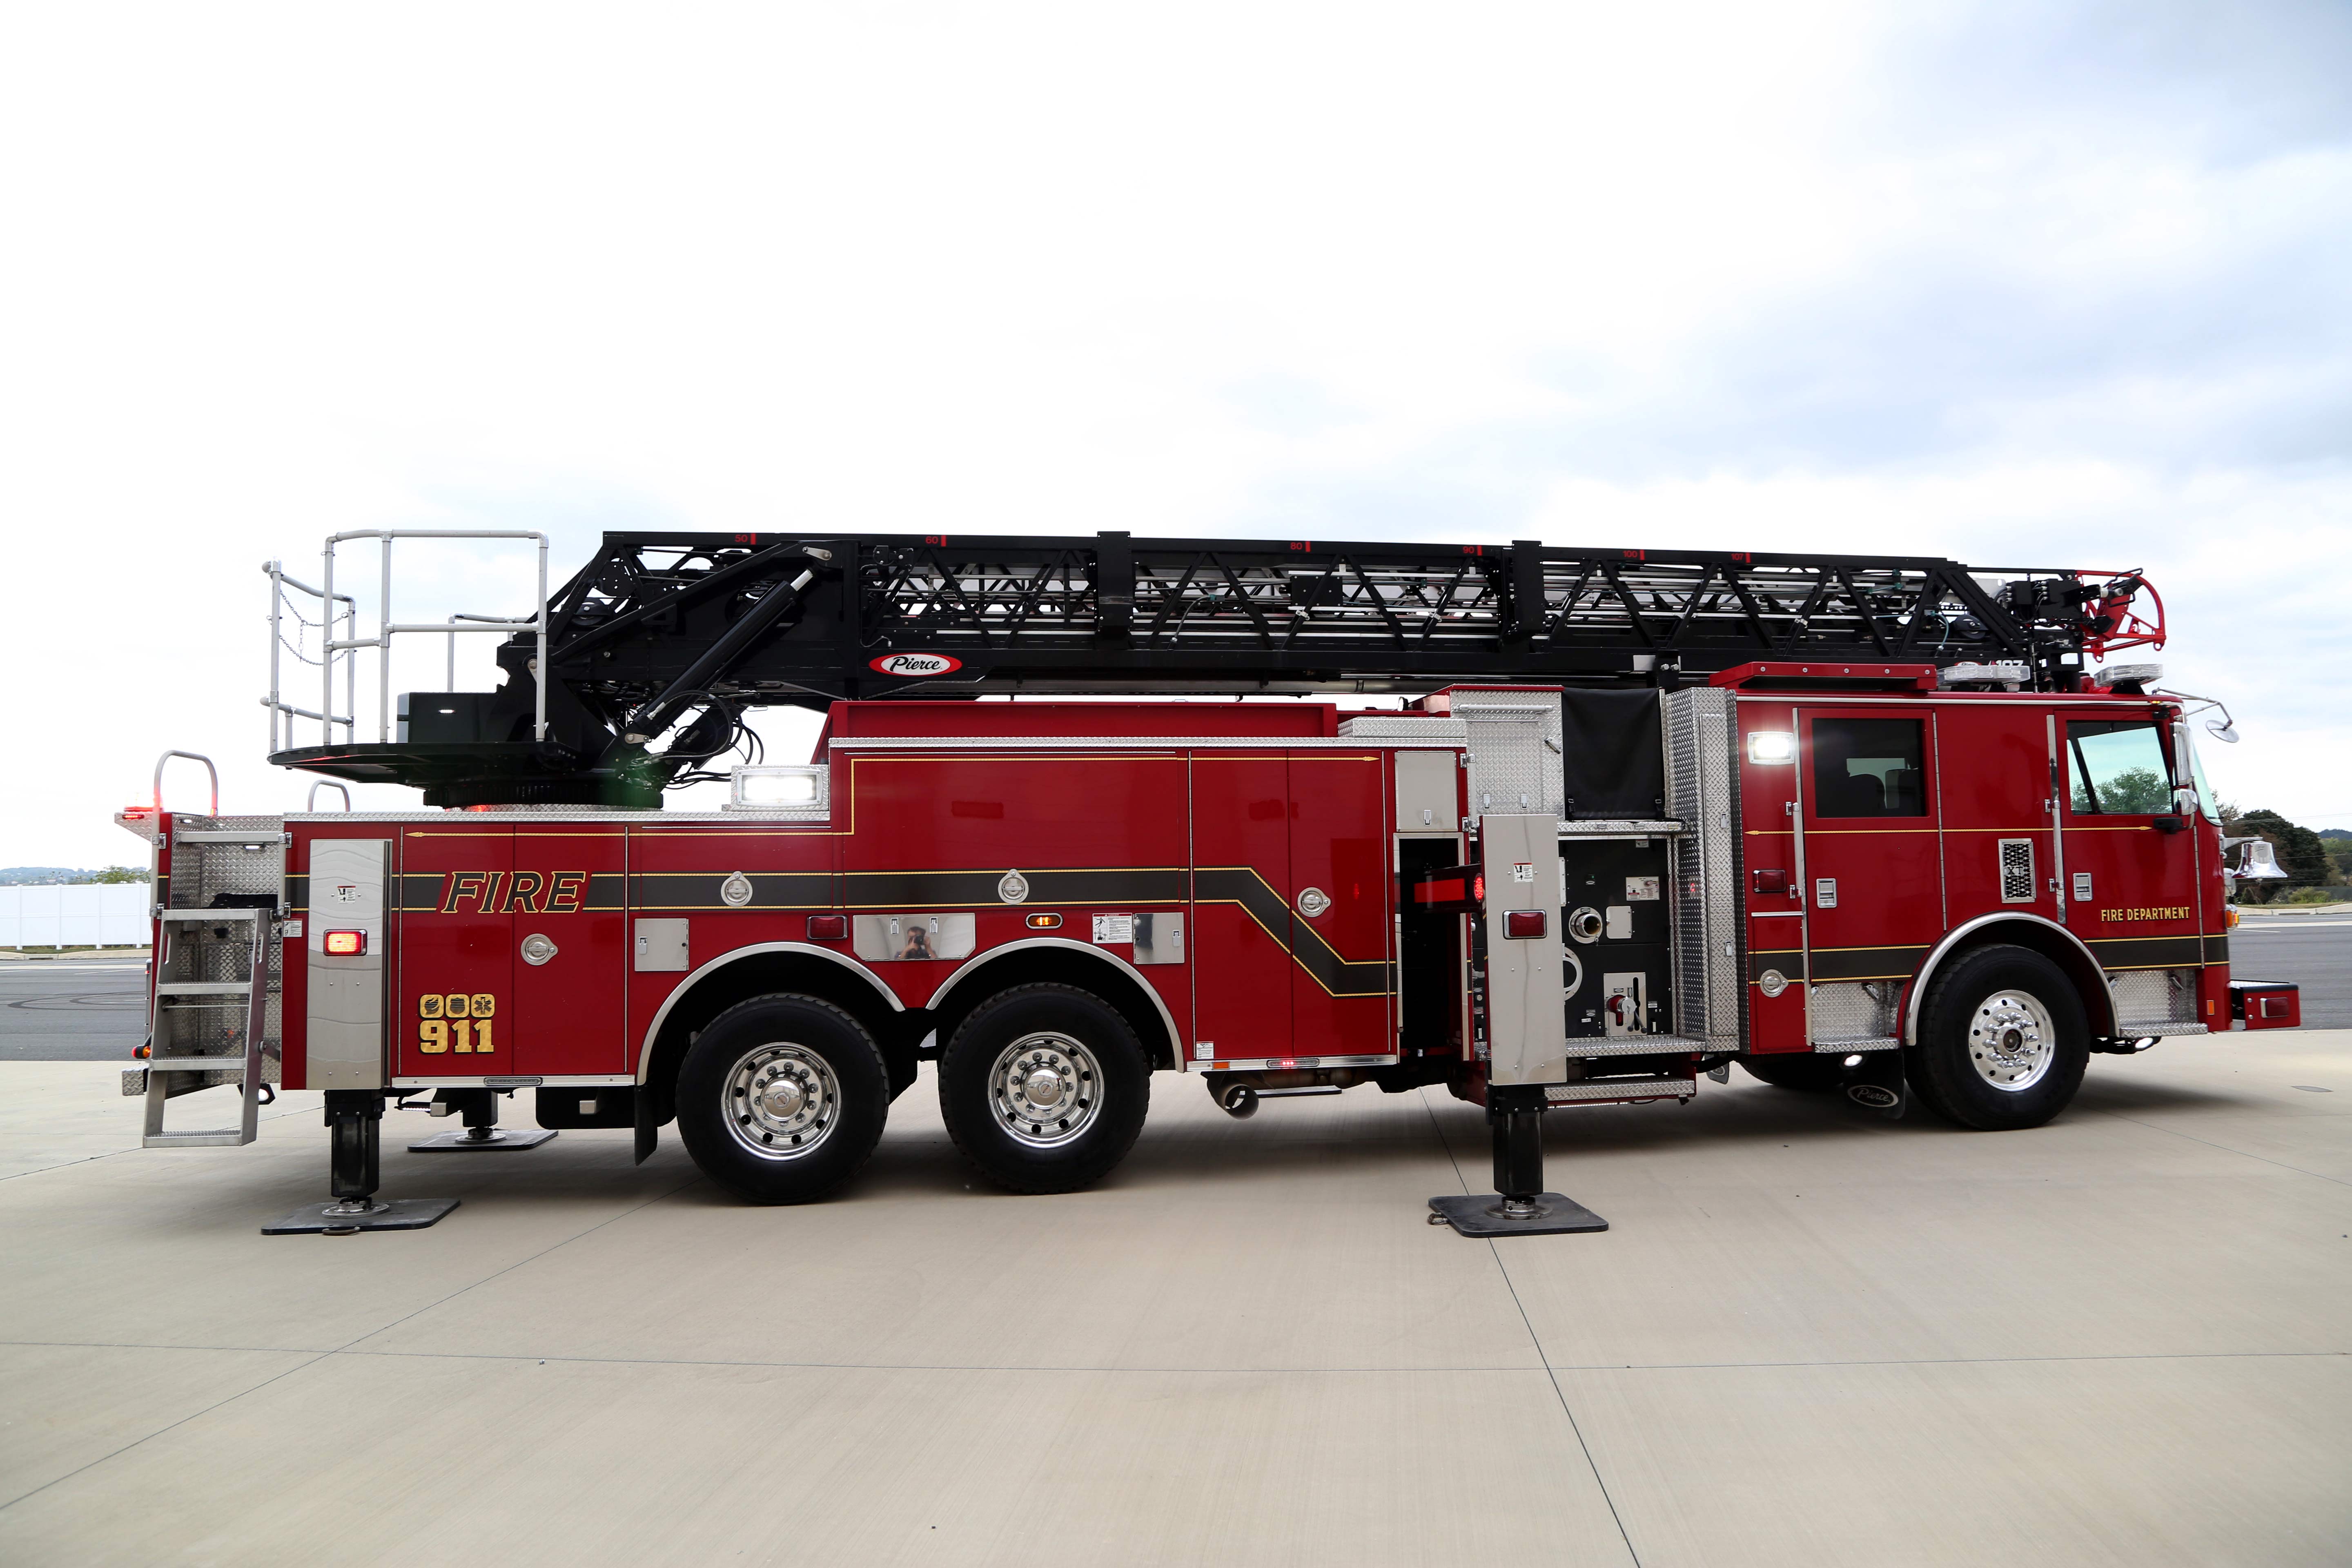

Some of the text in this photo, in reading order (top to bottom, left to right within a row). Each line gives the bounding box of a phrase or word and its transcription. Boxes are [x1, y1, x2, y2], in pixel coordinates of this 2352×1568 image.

[890, 656, 940, 672] Pierce
[441, 871, 586, 913] FIRE
[2101, 906, 2190, 922] FIRE DEPARTMENT
[420, 1020, 494, 1053] 911
[1857, 1088, 1889, 1101] Pierce
